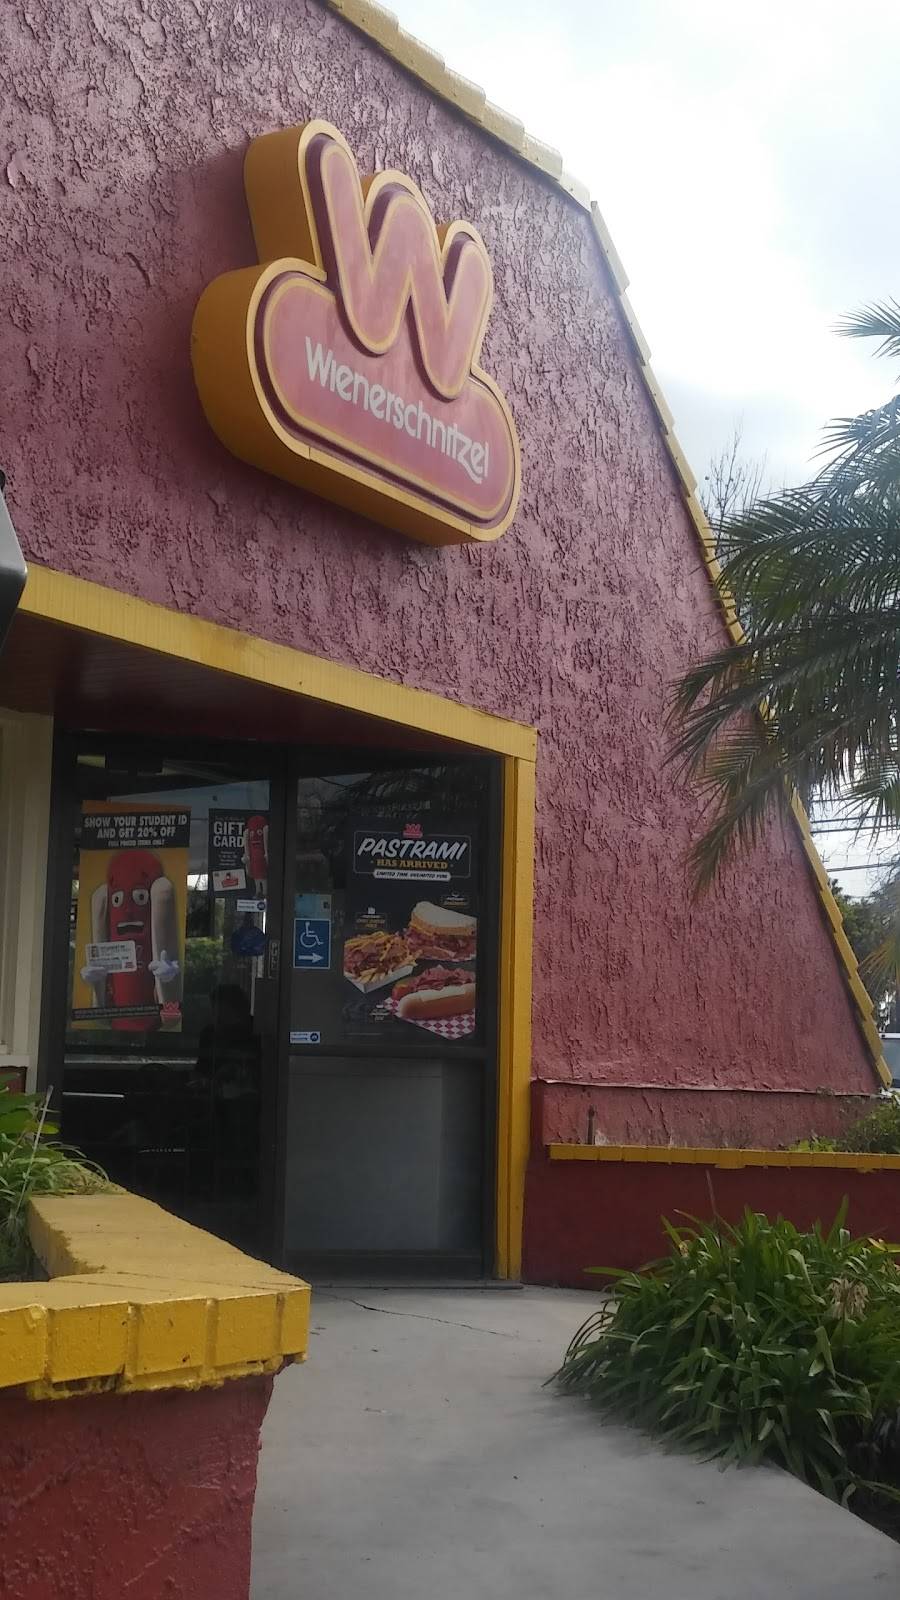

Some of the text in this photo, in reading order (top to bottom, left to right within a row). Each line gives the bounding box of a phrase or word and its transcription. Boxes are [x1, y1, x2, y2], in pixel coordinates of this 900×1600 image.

[304, 335, 490, 485] Wienerschnitzel
[84, 814, 187, 829] SHOW YOUR STUDENT ID
[213, 821, 245, 835] GIFT
[97, 826, 176, 839] AND GET 20% OFF
[213, 835, 245, 848] CARD
[357, 837, 468, 861] PASTRAMI
[376, 858, 449, 870] HAS ARRIVED
